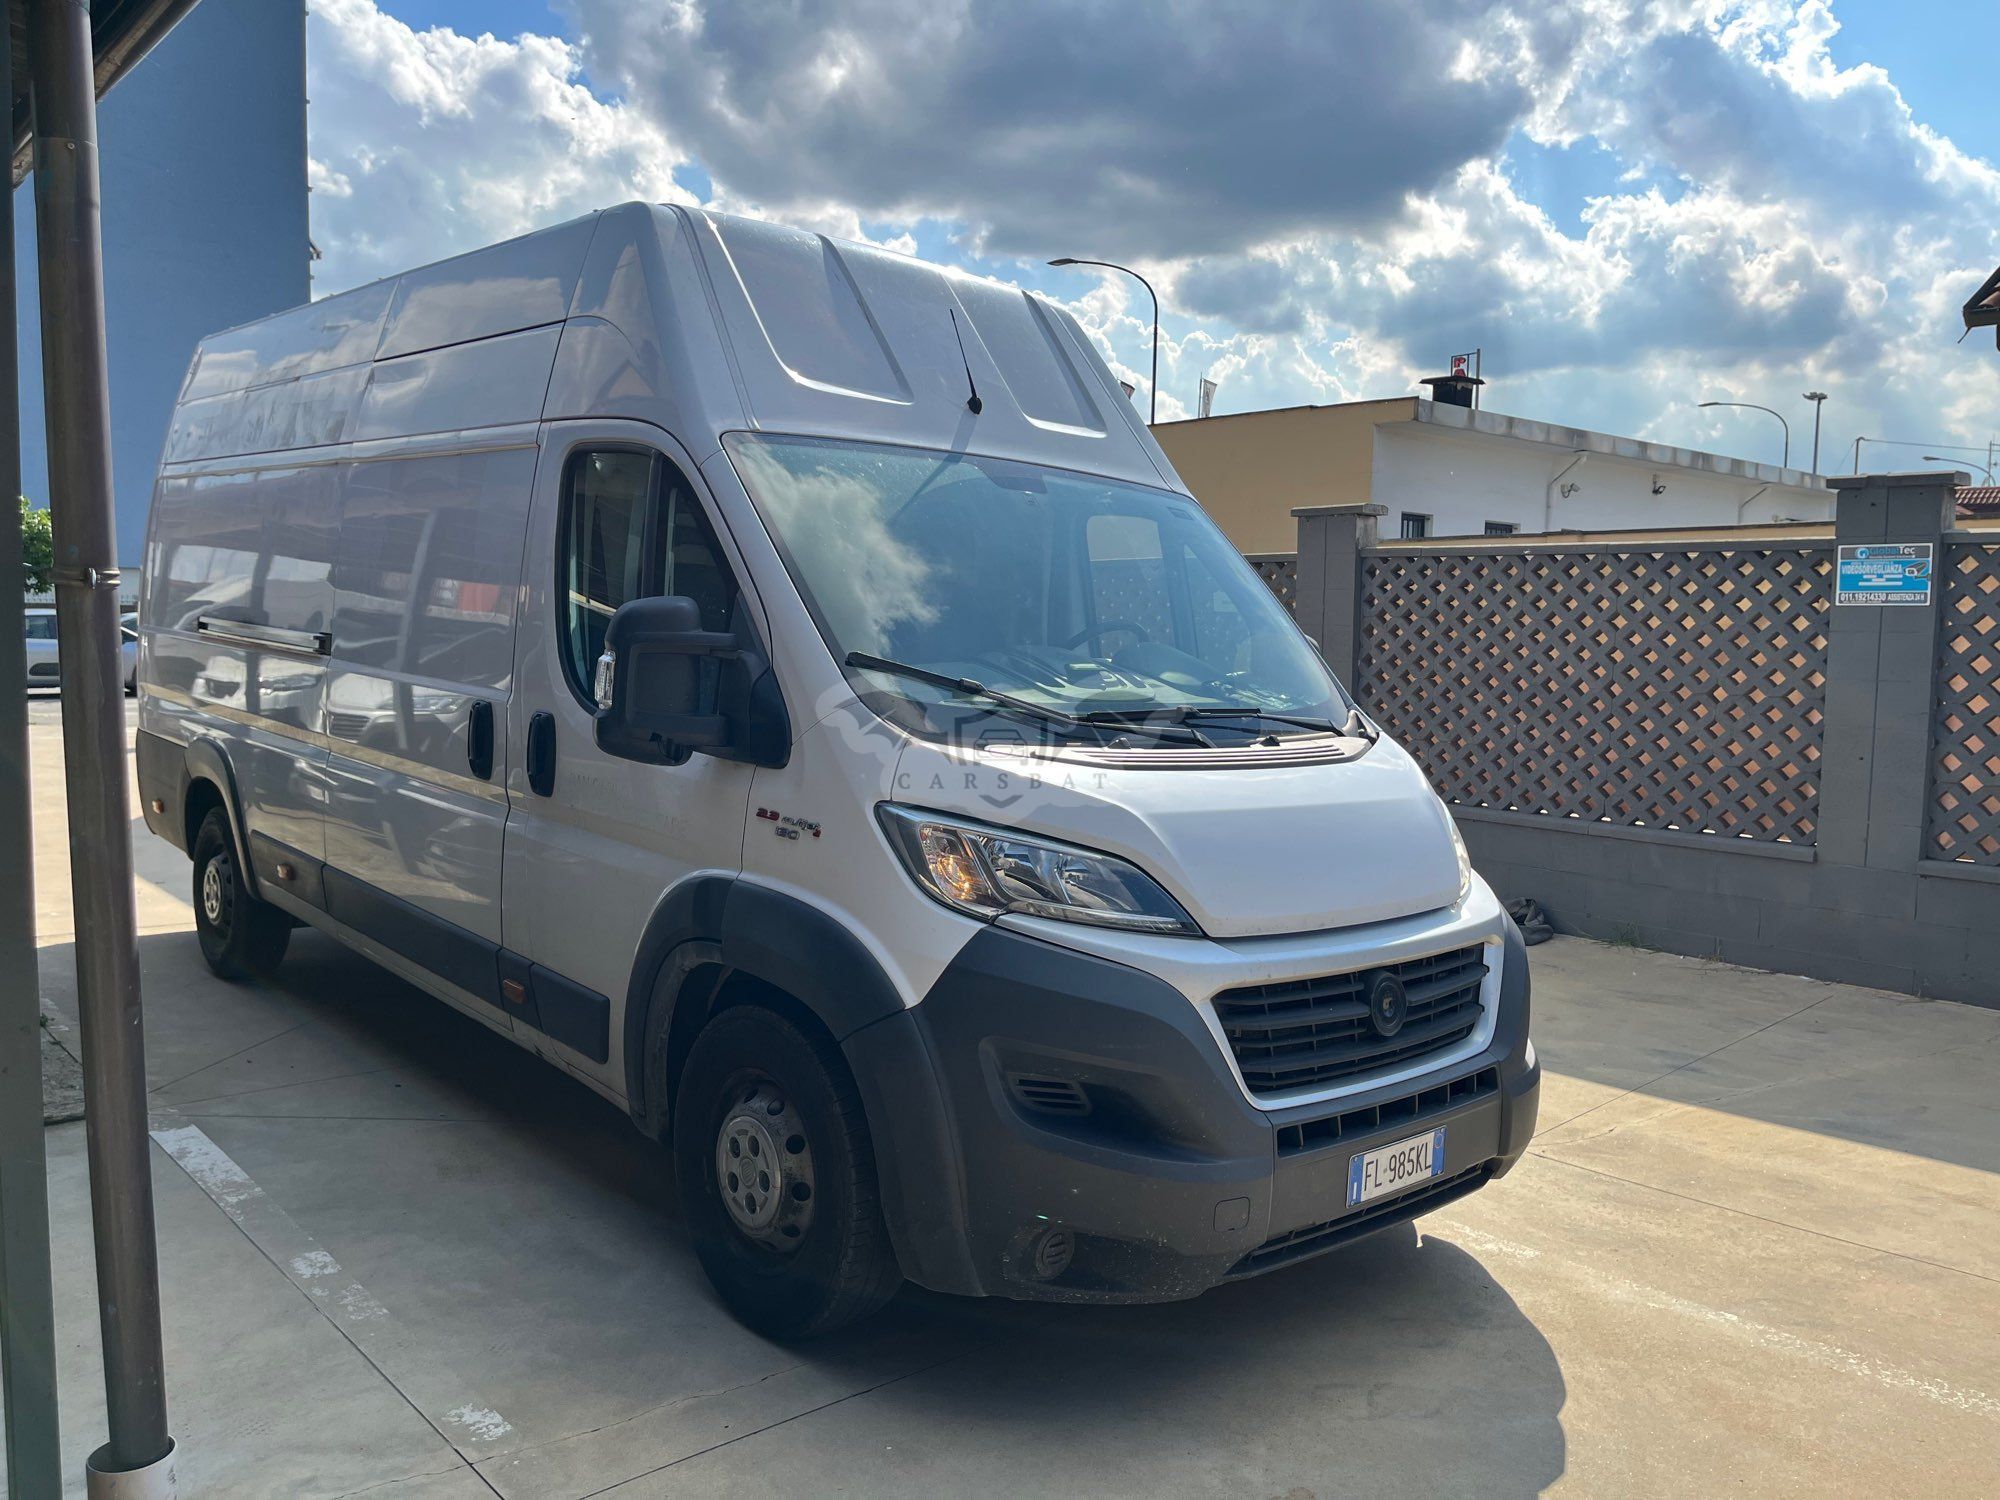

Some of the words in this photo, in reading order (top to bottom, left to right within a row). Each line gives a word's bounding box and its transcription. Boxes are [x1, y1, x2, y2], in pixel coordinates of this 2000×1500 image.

[1841, 564, 1902, 575] VIDEOSORVEGLIANZA
[1840, 593, 1886, 601] 011.19214330
[1364, 1158, 1383, 1192] FL
[1388, 1142, 1432, 1184] 985KL
